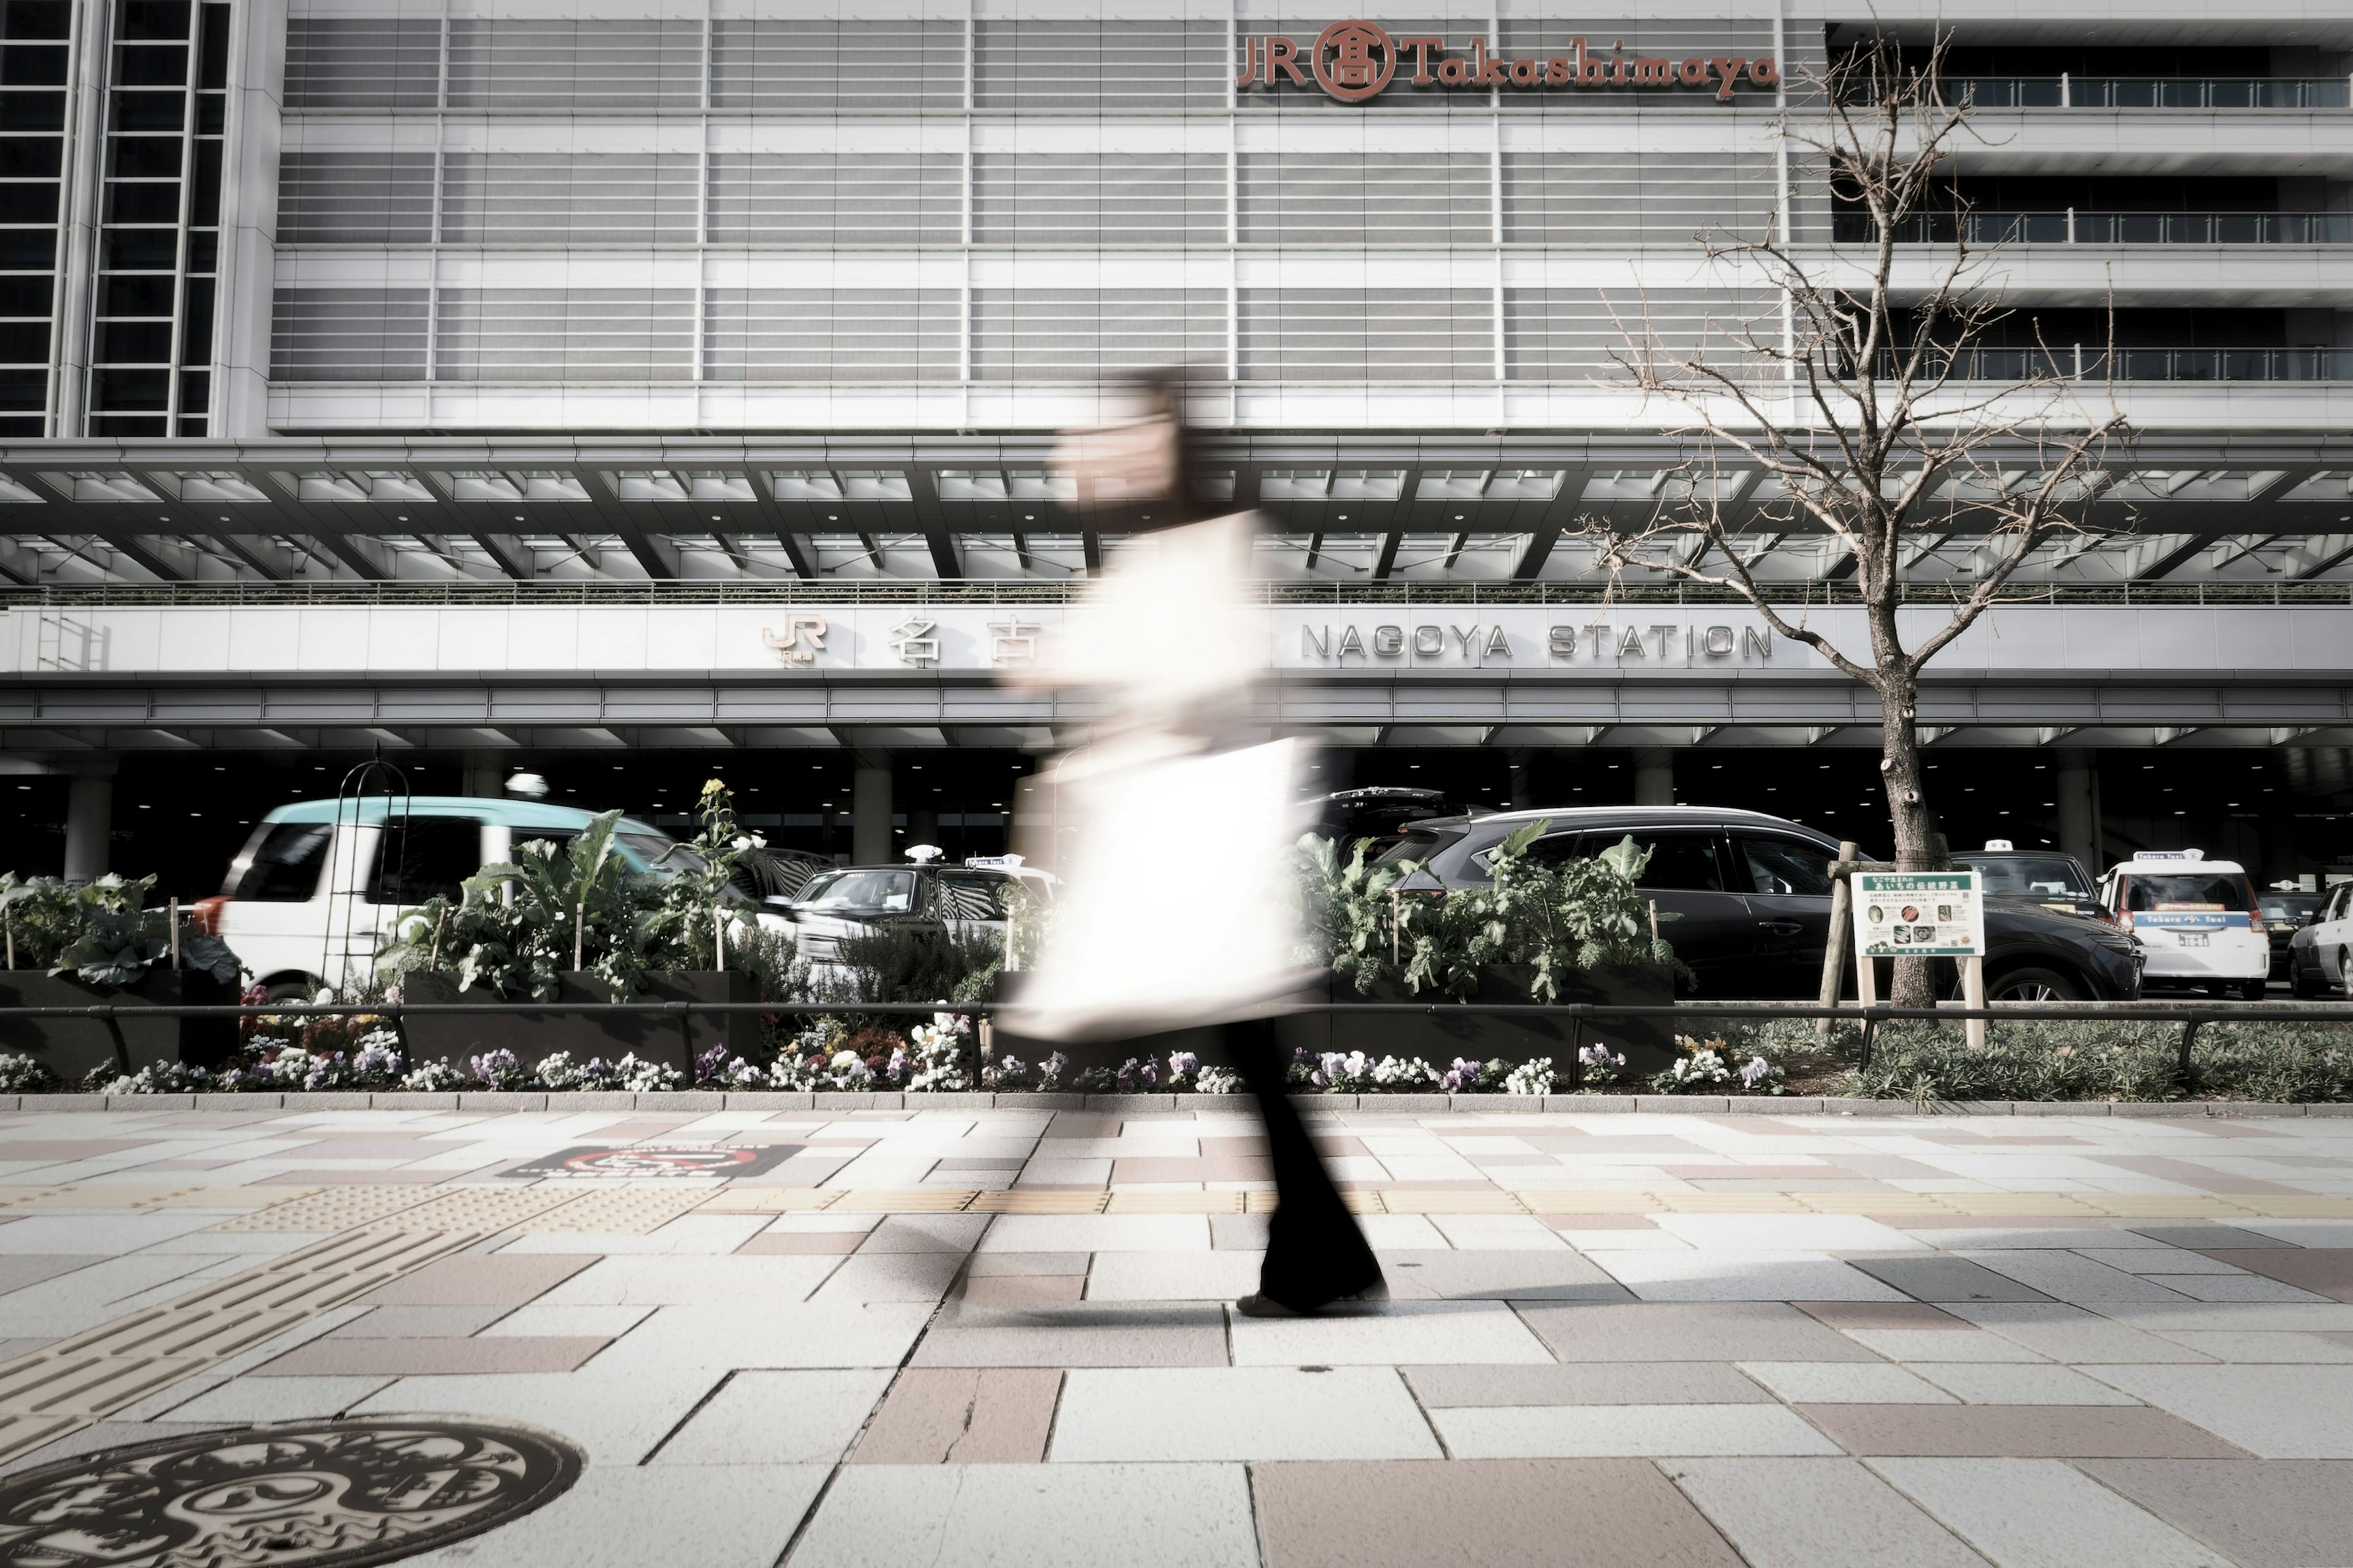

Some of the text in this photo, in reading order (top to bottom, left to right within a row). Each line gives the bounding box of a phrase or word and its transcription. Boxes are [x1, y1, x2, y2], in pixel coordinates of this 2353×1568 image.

[1237, 36, 1308, 88] JR
[1400, 37, 1781, 102] Takashimaya
[762, 614, 827, 649] JR
[1302, 624, 1773, 657] NAGOYA STATION
[1876, 881, 1959, 890] あいちの伝統野菜
